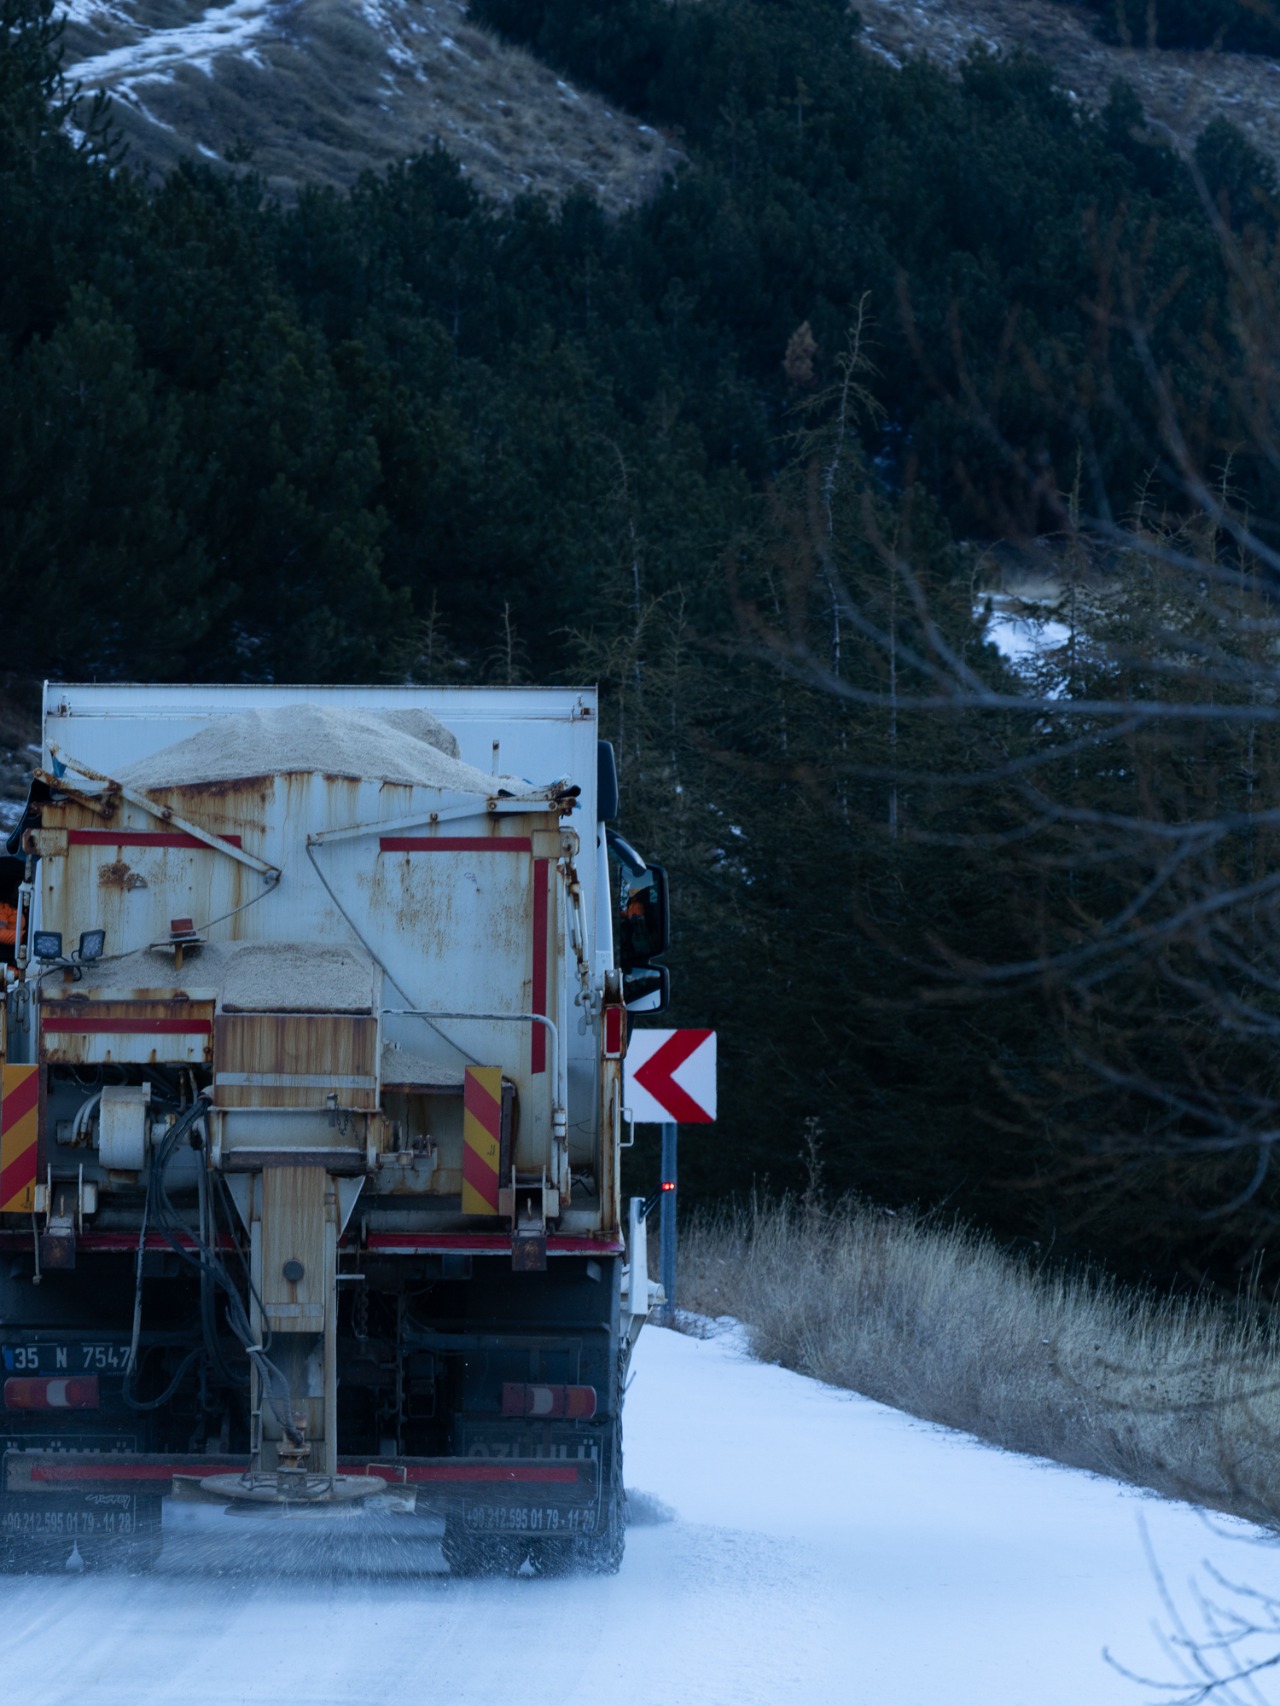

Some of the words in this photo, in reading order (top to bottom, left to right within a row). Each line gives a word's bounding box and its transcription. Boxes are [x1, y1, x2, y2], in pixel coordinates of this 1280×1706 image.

[14, 1347, 39, 1369] 35
[56, 1346, 67, 1368] N
[82, 1346, 132, 1368] 7547
[66, 1512, 78, 1533] 01
[82, 1512, 94, 1533] 79
[103, 1512, 115, 1533] 11
[118, 1512, 131, 1533] 28
[530, 1508, 543, 1529] 01
[546, 1508, 559, 1529] 79
[567, 1508, 579, 1530] 11
